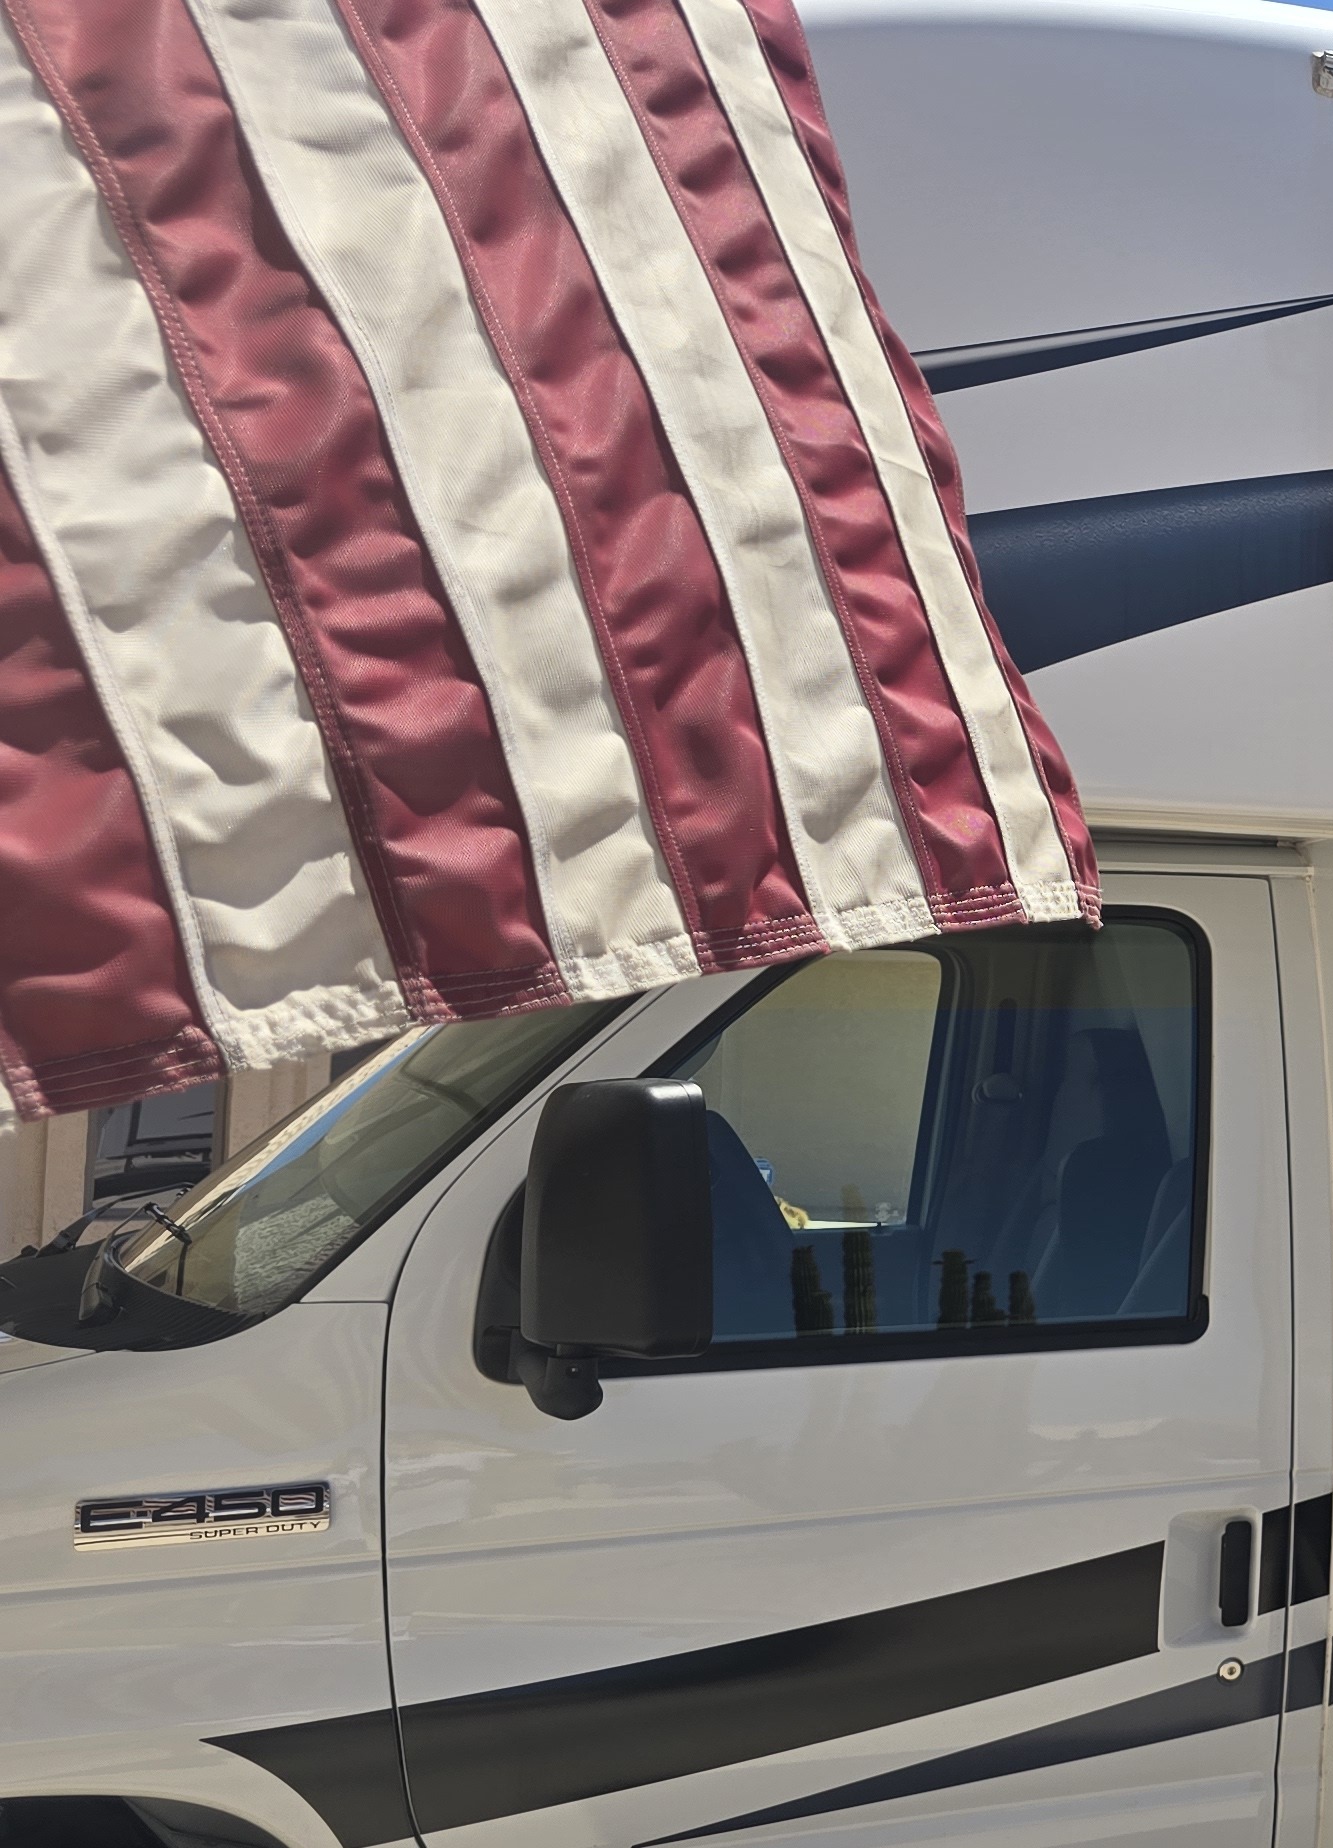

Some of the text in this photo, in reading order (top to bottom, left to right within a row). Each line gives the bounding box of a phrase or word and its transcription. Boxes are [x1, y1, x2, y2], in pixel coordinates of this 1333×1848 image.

[80, 1485, 324, 1533] E-450
[190, 1521, 321, 1540] SUPER DUTY
